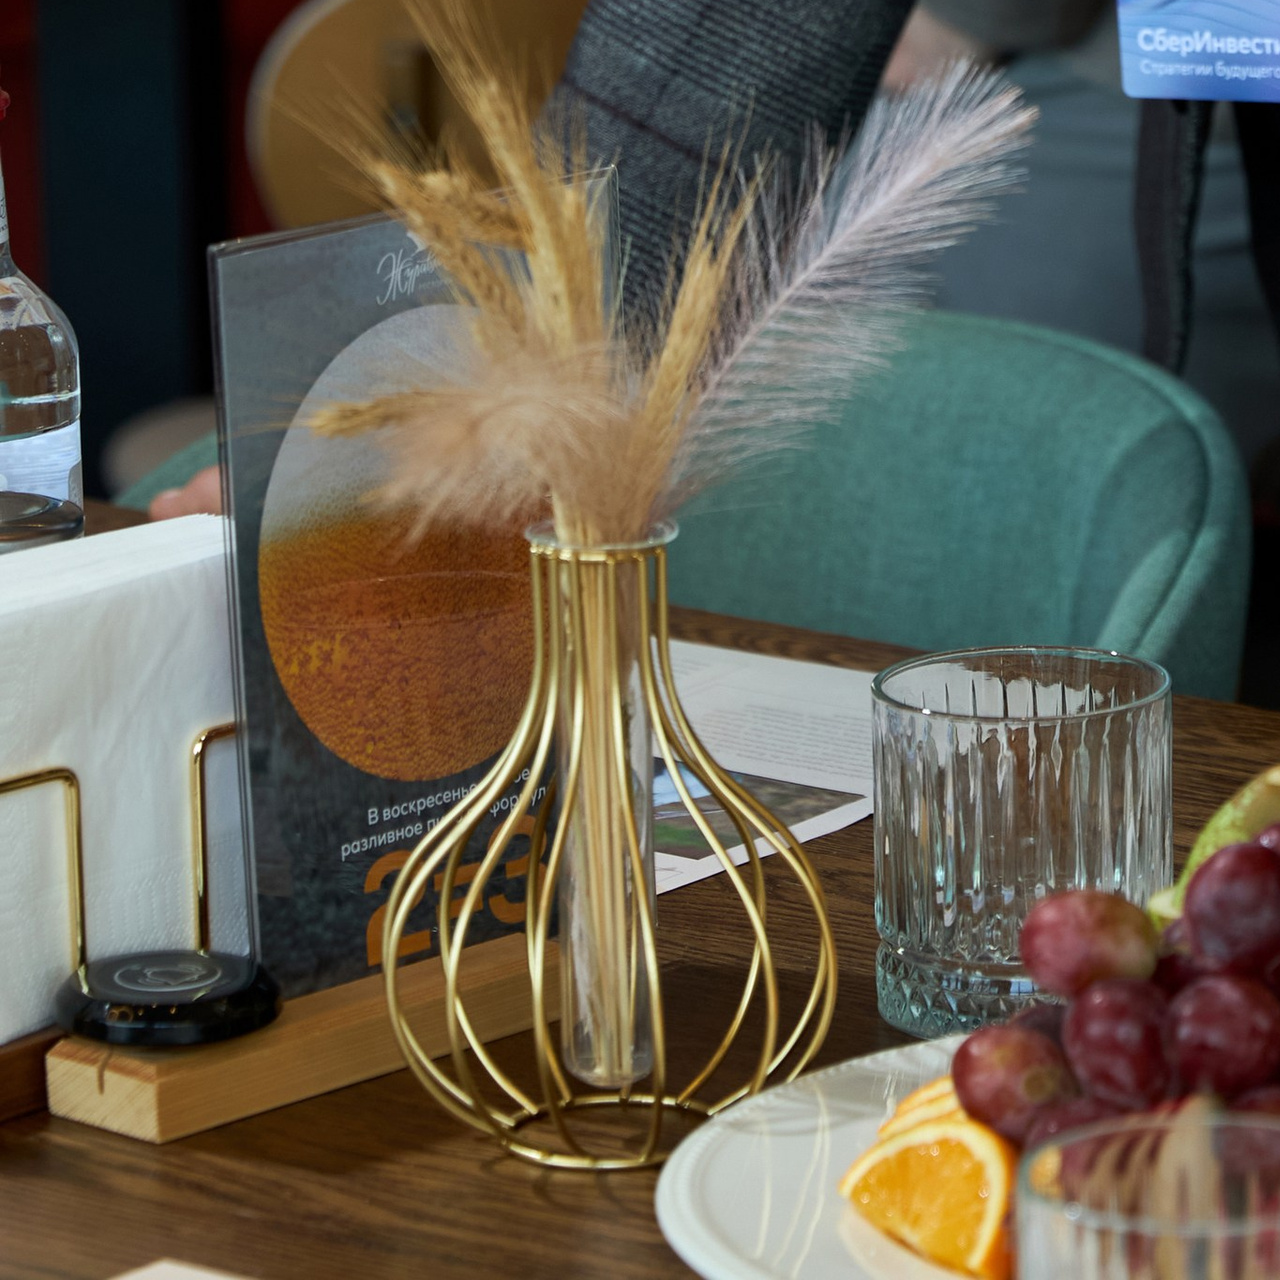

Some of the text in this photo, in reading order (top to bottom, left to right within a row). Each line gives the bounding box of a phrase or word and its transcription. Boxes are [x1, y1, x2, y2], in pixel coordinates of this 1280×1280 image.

[1139, 60, 1213, 78] Стратегии
[367, 808, 379, 825] В
[341, 824, 423, 862] разливное
